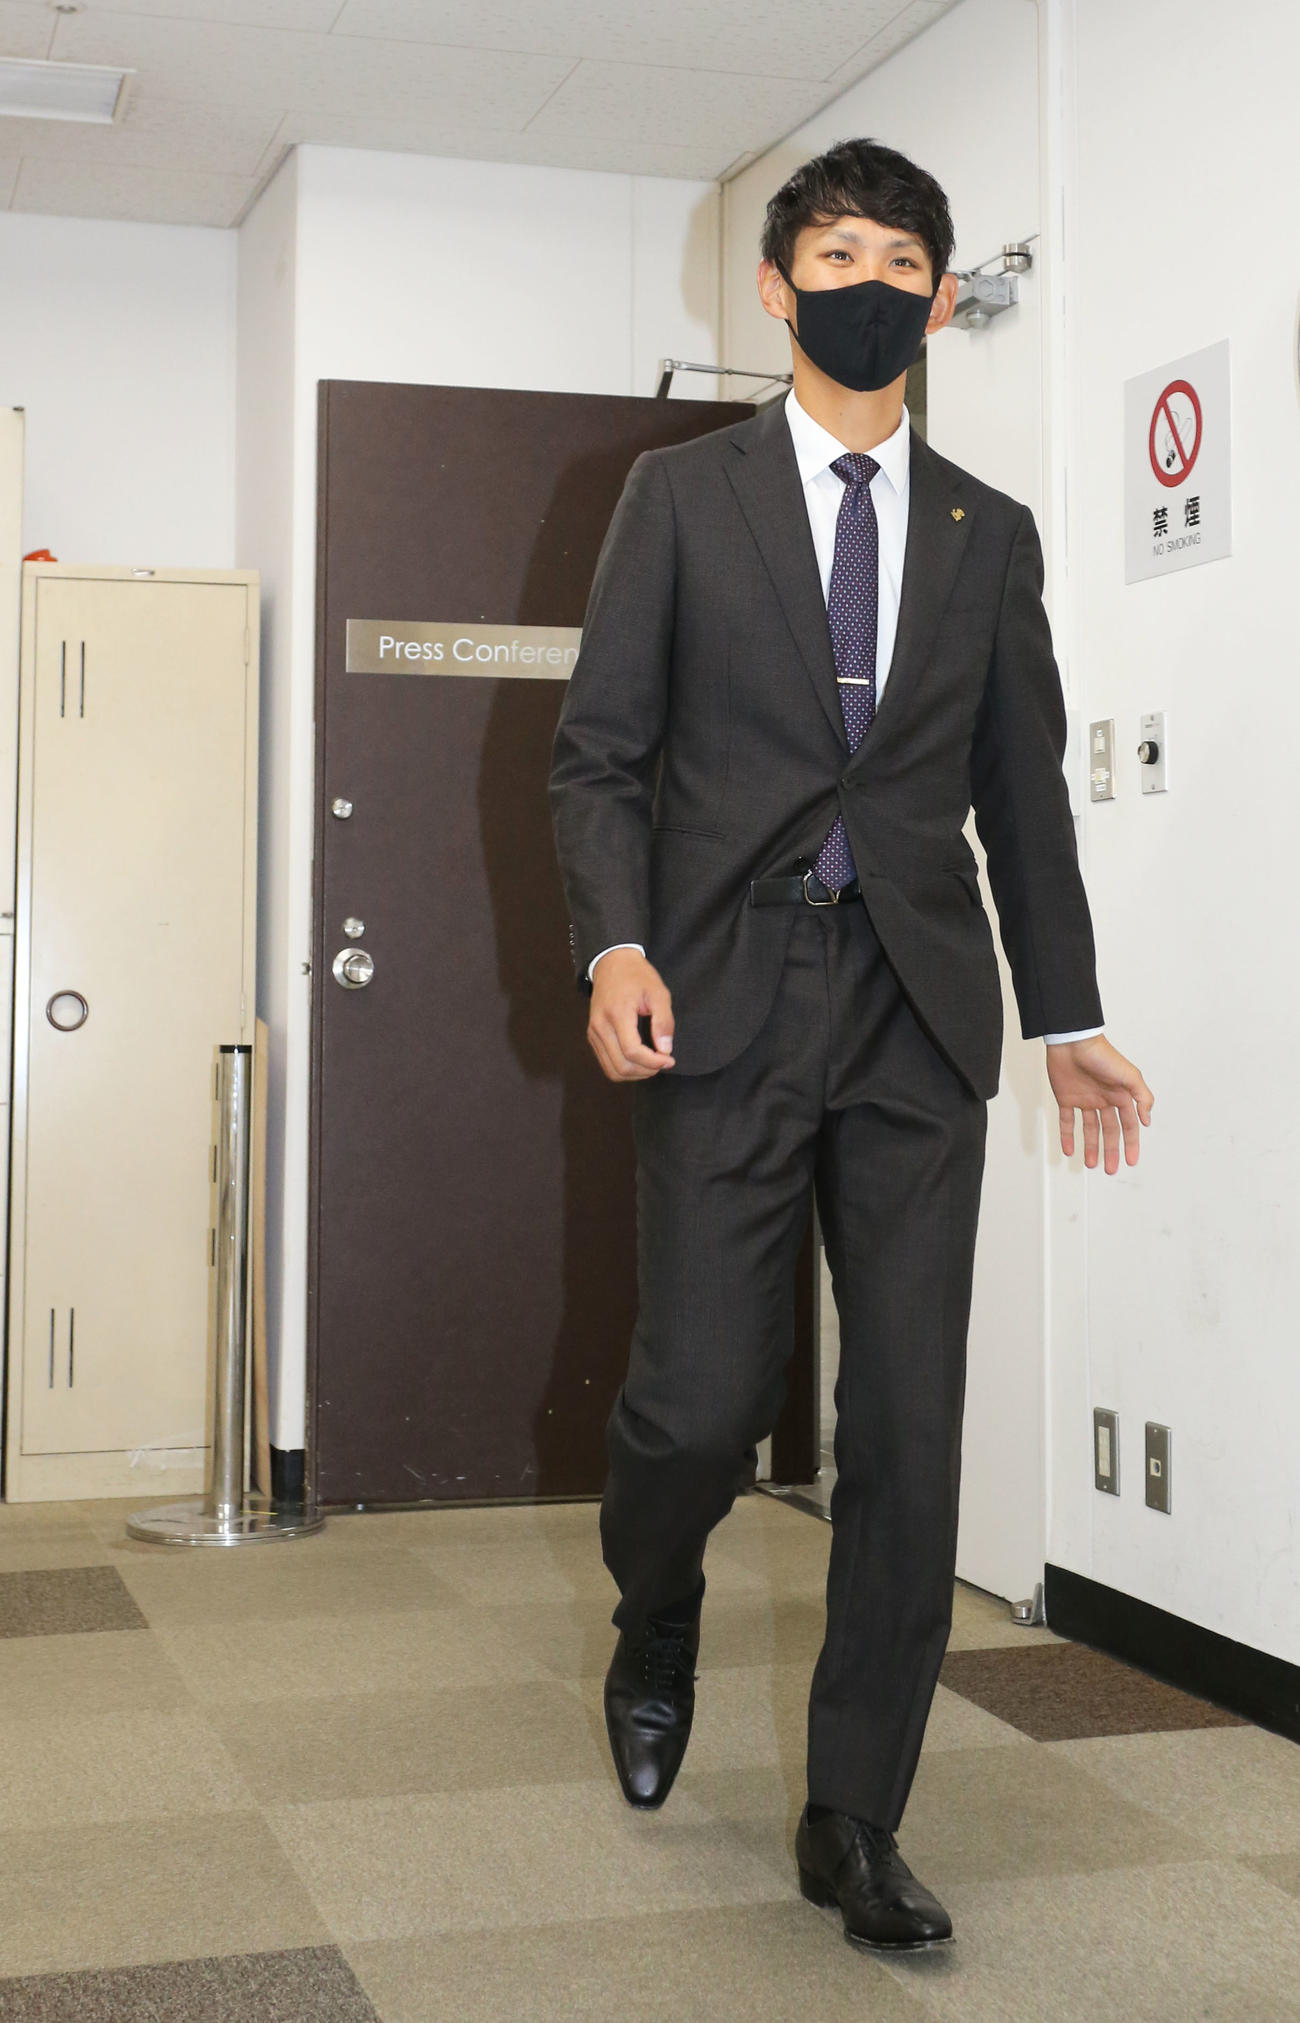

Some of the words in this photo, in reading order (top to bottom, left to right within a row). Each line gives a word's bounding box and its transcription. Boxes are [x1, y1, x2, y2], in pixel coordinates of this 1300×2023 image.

[1152, 495, 1201, 538] 禁煙
[1152, 543, 1165, 556] NO
[1167, 532, 1201, 552] SMOKING
[379, 635, 445, 661] Press
[452, 638, 580, 665] Conferen
